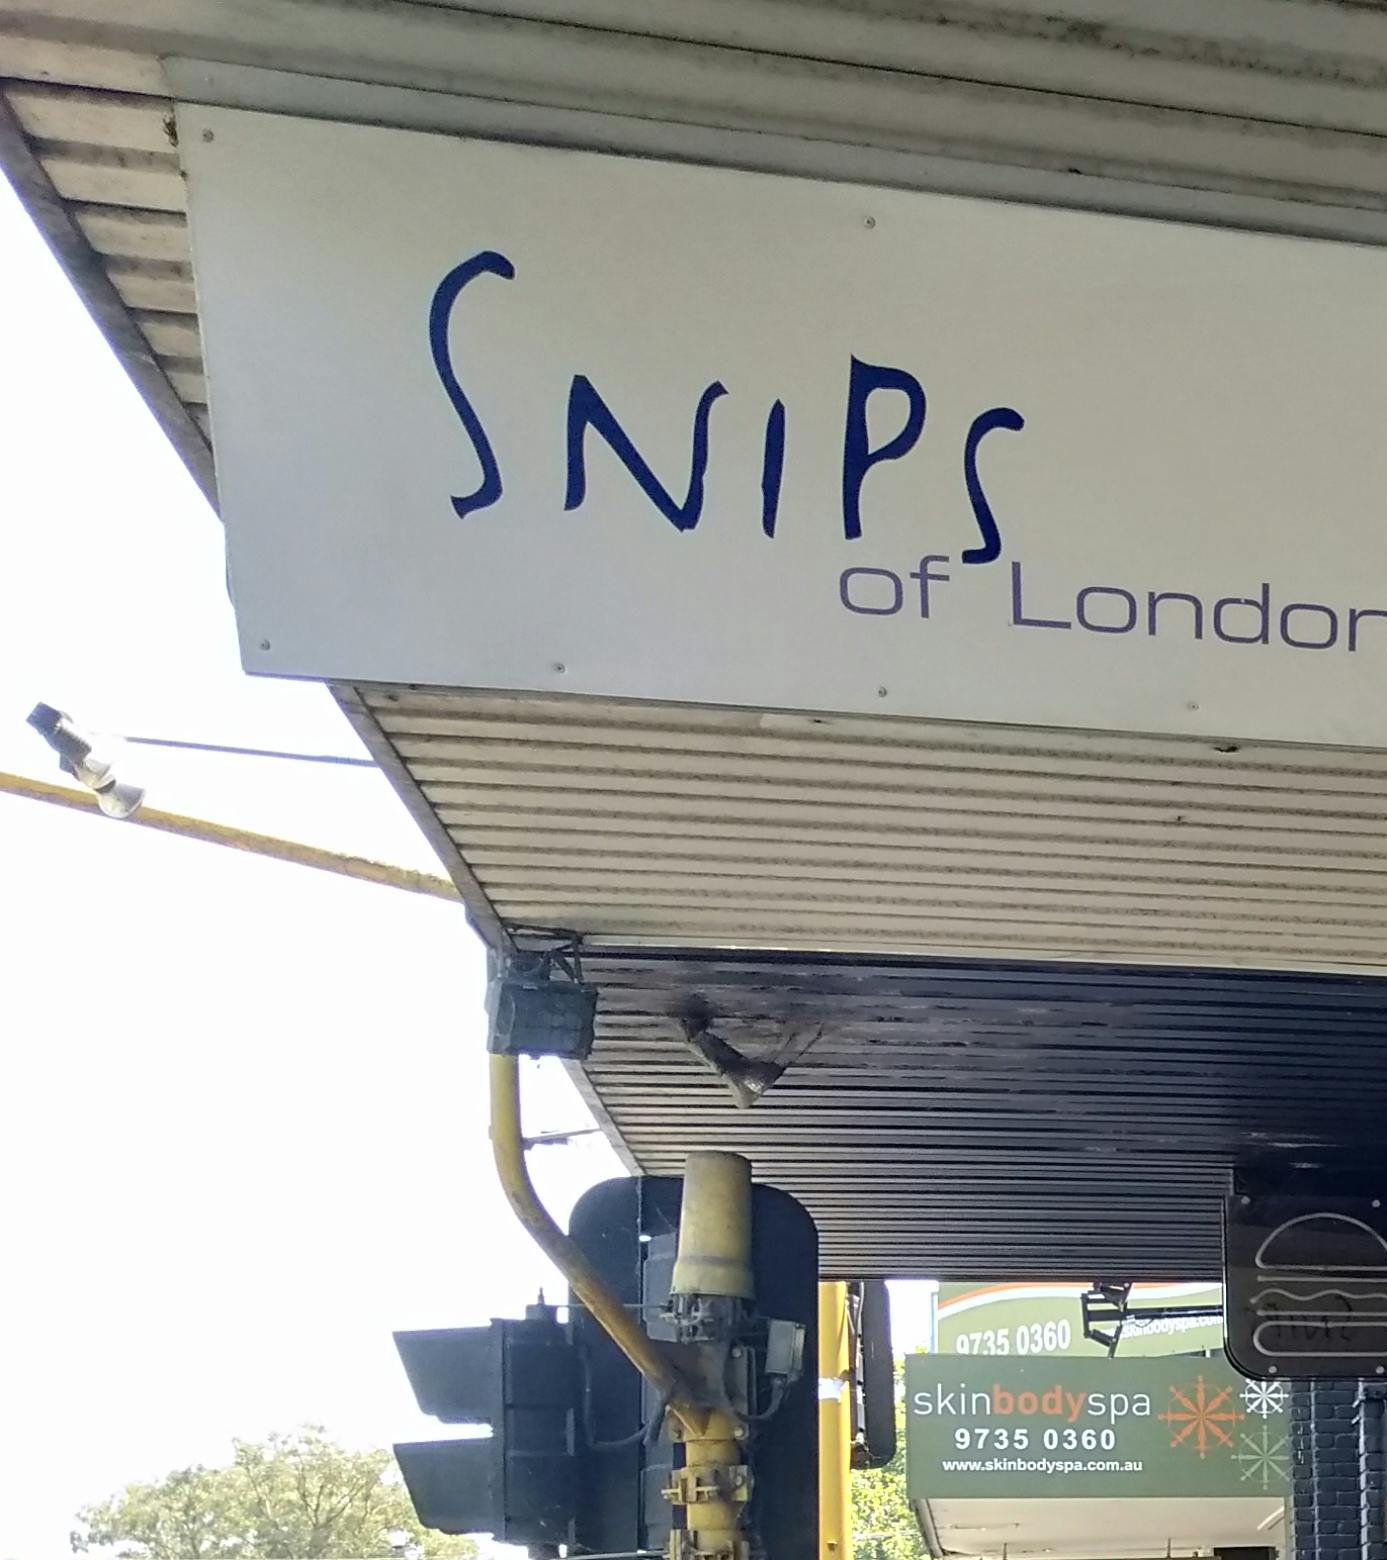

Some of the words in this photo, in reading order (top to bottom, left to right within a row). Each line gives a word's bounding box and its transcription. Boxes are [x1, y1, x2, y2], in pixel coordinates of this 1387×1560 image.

[429, 251, 1025, 564] SNIPS
[839, 554, 952, 620] of
[955, 1328, 1010, 1355] 9735
[1016, 1319, 1071, 1354] 0360
[912, 1383, 1151, 1425] skinbodyspa
[954, 1427, 1029, 1450] 9735
[1043, 1428, 1116, 1450] 0360
[942, 1457, 1143, 1474] www.skinbodyspa.com.au
